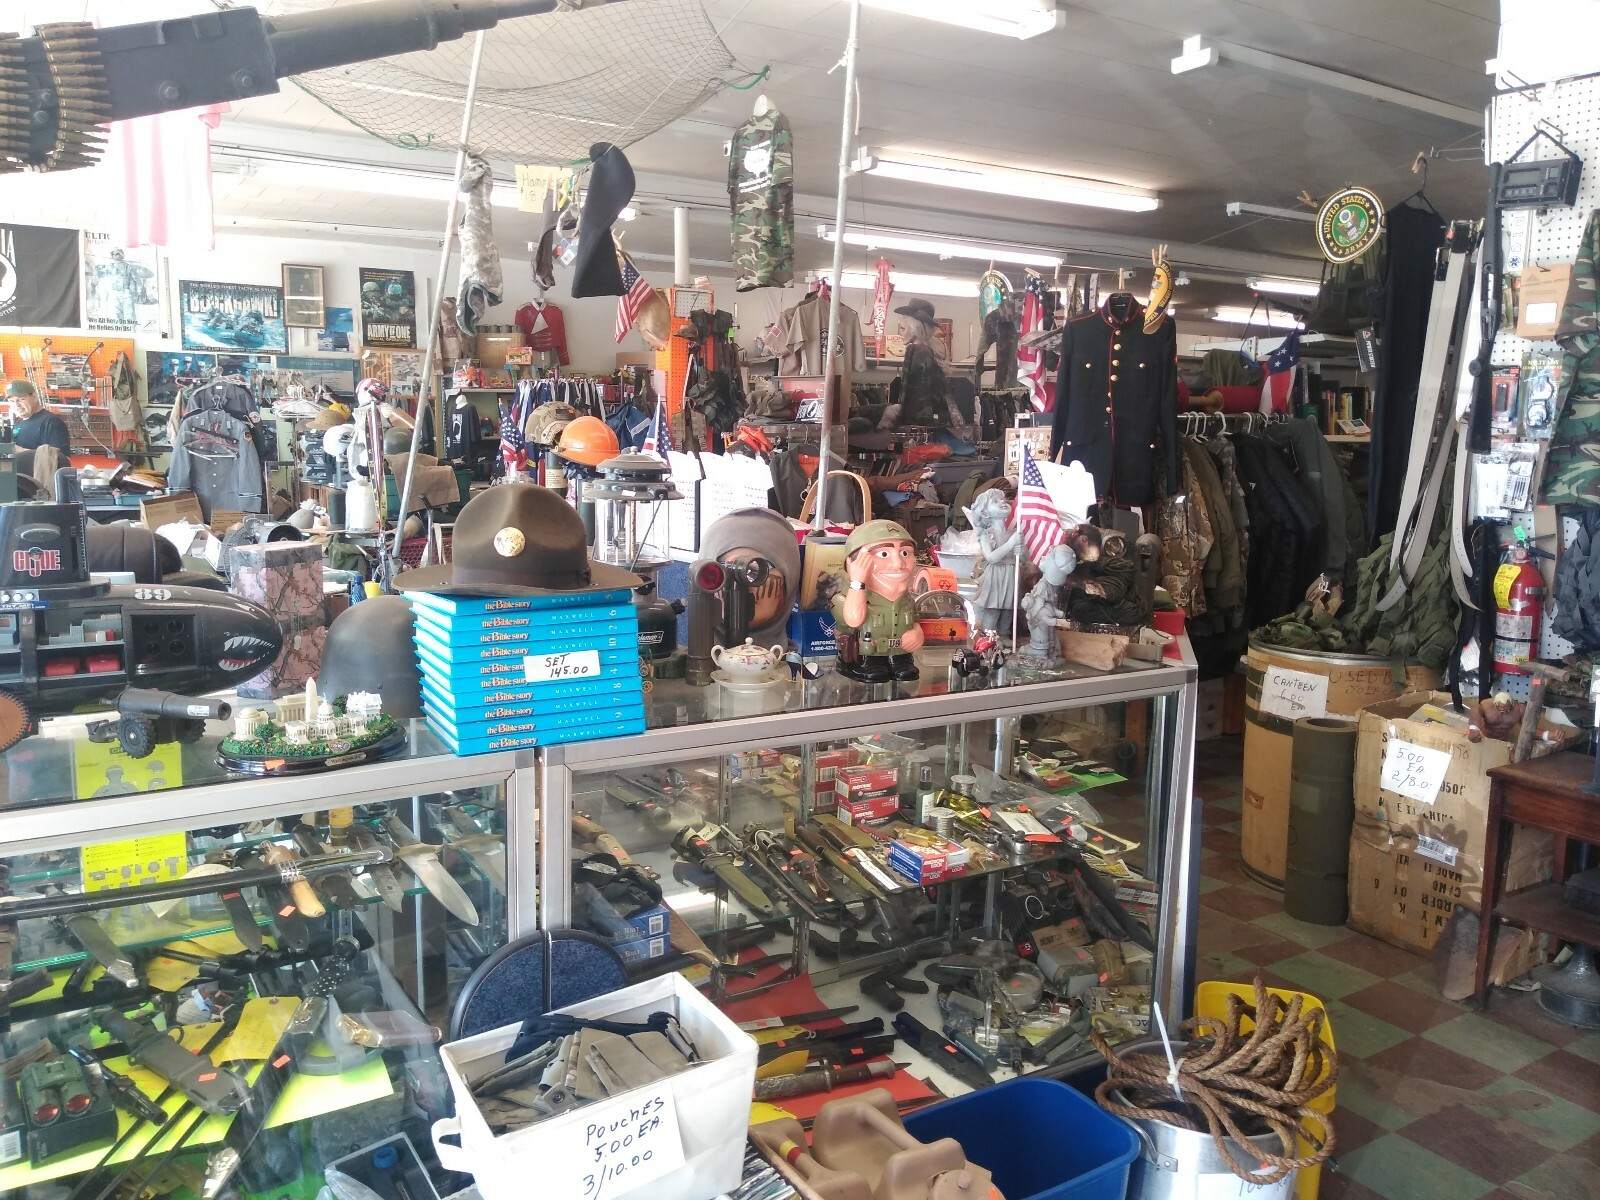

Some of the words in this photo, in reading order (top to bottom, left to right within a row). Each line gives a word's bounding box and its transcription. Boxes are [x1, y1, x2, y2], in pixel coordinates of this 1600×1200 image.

[1324, 203, 1340, 234] UNITED
[1341, 195, 1367, 205] STATES
[1344, 235, 1368, 255] ARMY
[367, 324, 389, 338] ARMY
[396, 325, 411, 338] ONE
[134, 588, 172, 601] 89
[485, 603, 496, 611] the
[494, 600, 515, 609] Bible
[492, 617, 512, 627] Bible
[513, 618, 530, 626] story
[491, 632, 511, 641] Bible
[551, 627, 594, 635] MAXWELL
[481, 650, 492, 658] the
[491, 647, 511, 656] Bible
[511, 648, 529, 656] story
[551, 642, 593, 650] MAXWELL
[545, 653, 570, 667] SET
[491, 664, 511, 673] Bible
[550, 665, 588, 678] 145.00
[491, 677, 512, 686] Bible
[1273, 676, 1318, 692] CANTEEN
[484, 695, 495, 703] the
[495, 692, 515, 701] Bible
[555, 686, 597, 694] MAXWELL
[485, 711, 496, 719] the
[495, 708, 515, 717] Bible
[555, 700, 598, 709] MAXWELL
[487, 727, 498, 735] the
[497, 723, 517, 733] Bible
[518, 723, 536, 731] story
[557, 716, 600, 724] MAXWELL
[499, 738, 519, 747] Bible
[559, 729, 602, 738] MAXWELL
[1396, 747, 1425, 763] 5.00
[1422, 893, 1452, 913] RDER
[594, 1134, 633, 1163] 5.00
[582, 1150, 653, 1200] 3/10.00
